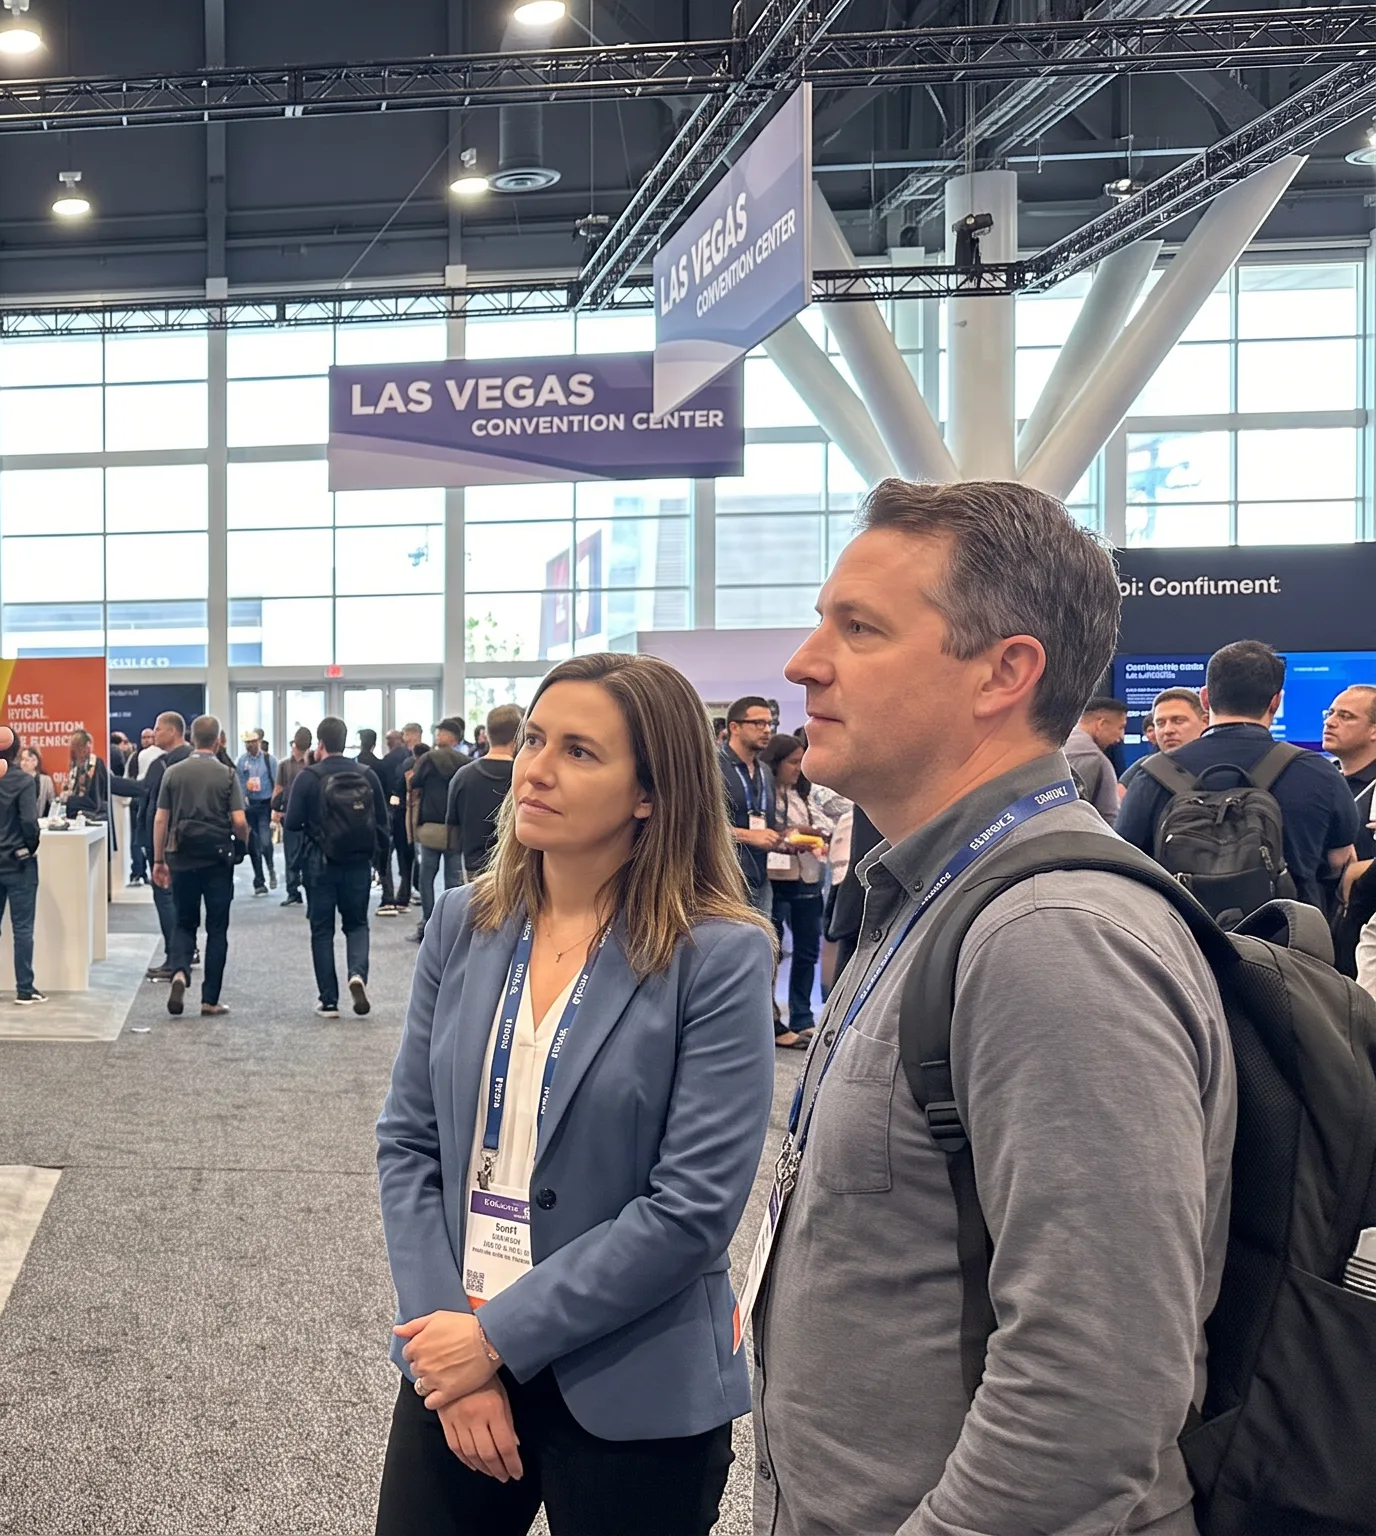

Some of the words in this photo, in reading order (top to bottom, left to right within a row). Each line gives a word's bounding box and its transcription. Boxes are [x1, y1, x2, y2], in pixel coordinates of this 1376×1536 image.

[660, 254, 689, 316] LAS
[691, 192, 748, 286] VEGAS
[696, 251, 754, 318] CONVENTION
[755, 208, 796, 265] CENTER
[351, 382, 432, 415] LAS
[445, 374, 594, 411] VEGAS
[471, 413, 625, 437] CONVENTION
